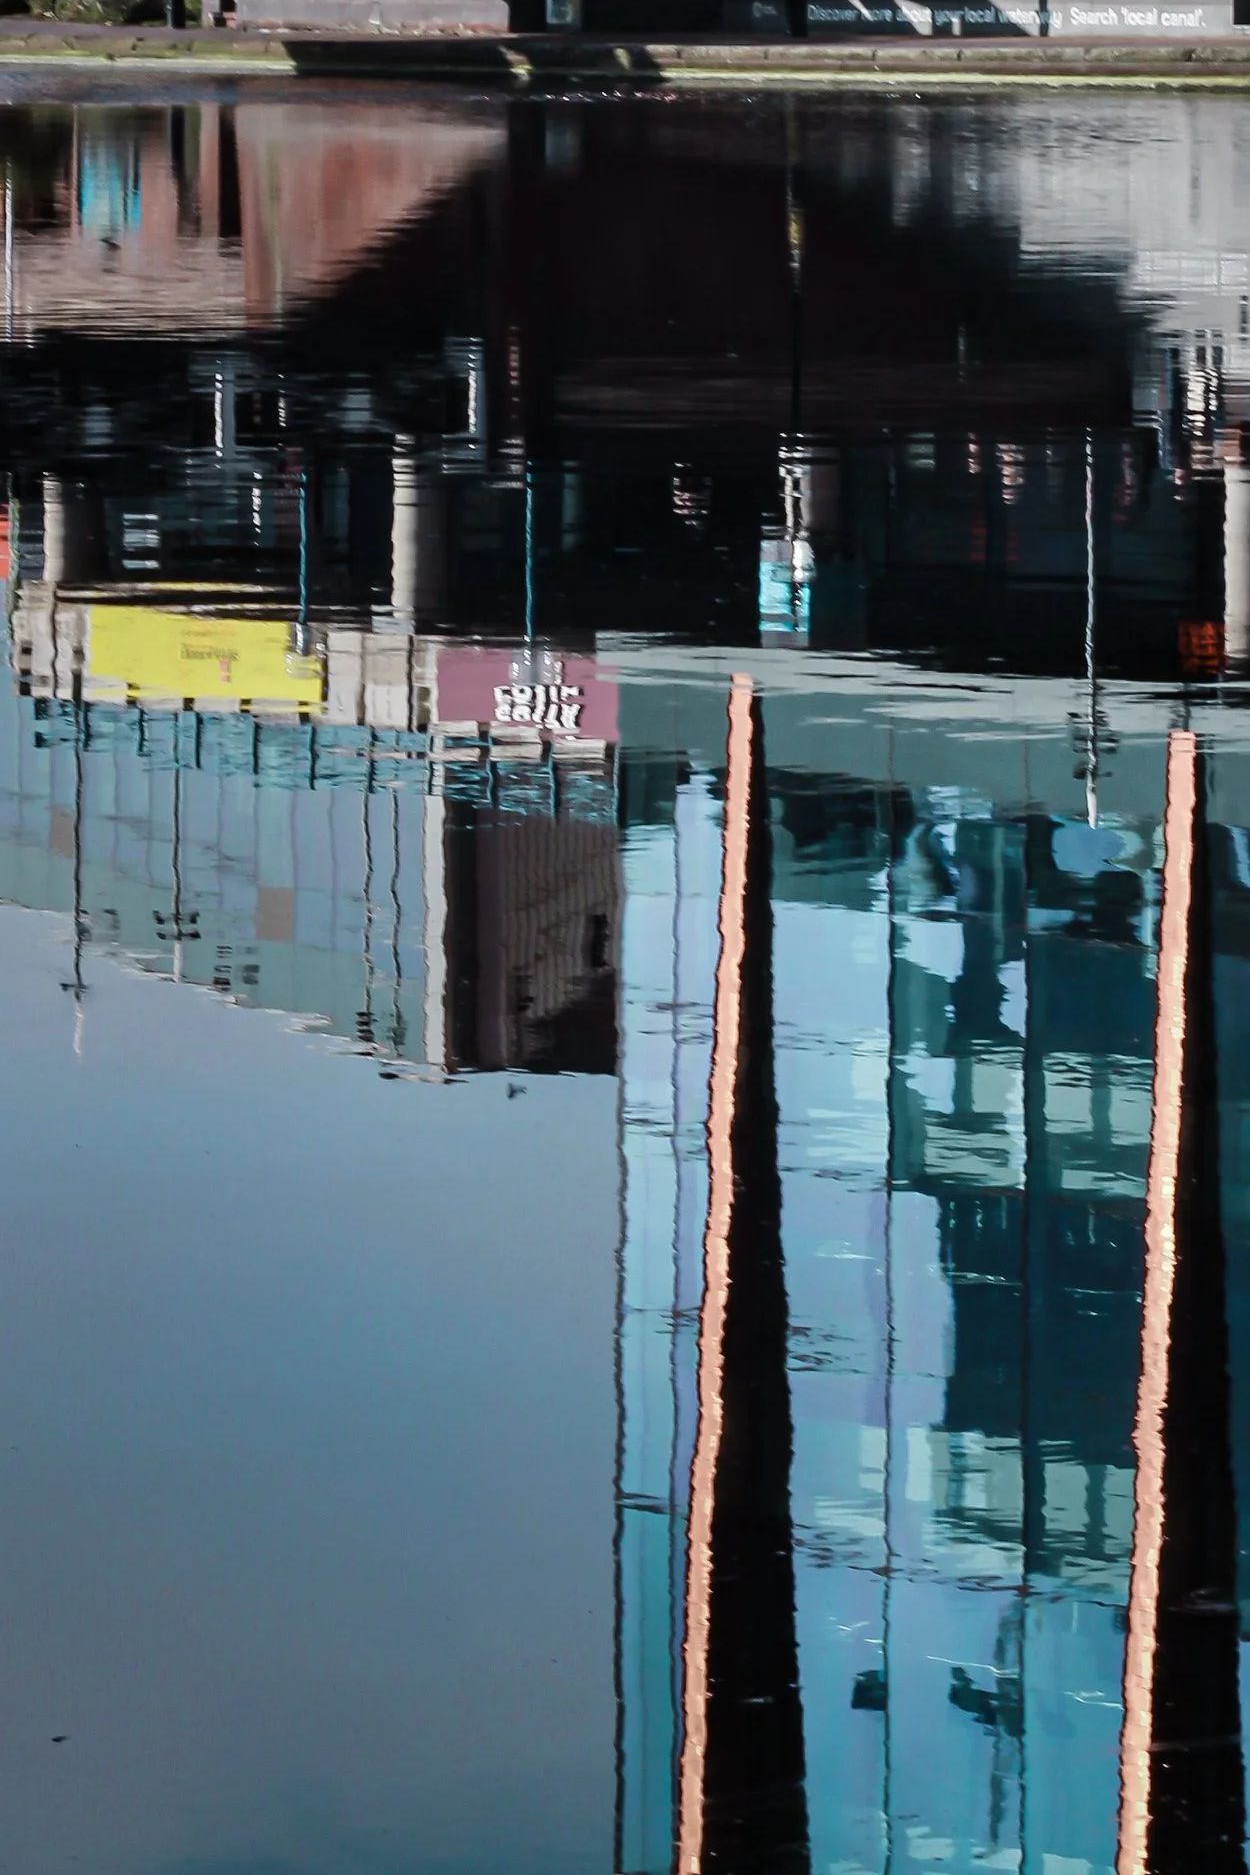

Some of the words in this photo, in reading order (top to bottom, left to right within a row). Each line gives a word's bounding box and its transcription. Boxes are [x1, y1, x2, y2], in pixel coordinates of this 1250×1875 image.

[808, 4, 859, 22] Discover
[861, 9, 893, 22] more
[895, 5, 932, 23] about
[934, 9, 963, 26] your
[964, 6, 995, 24] local
[997, 7, 1062, 29] waterway
[1070, 6, 1118, 25] Search
